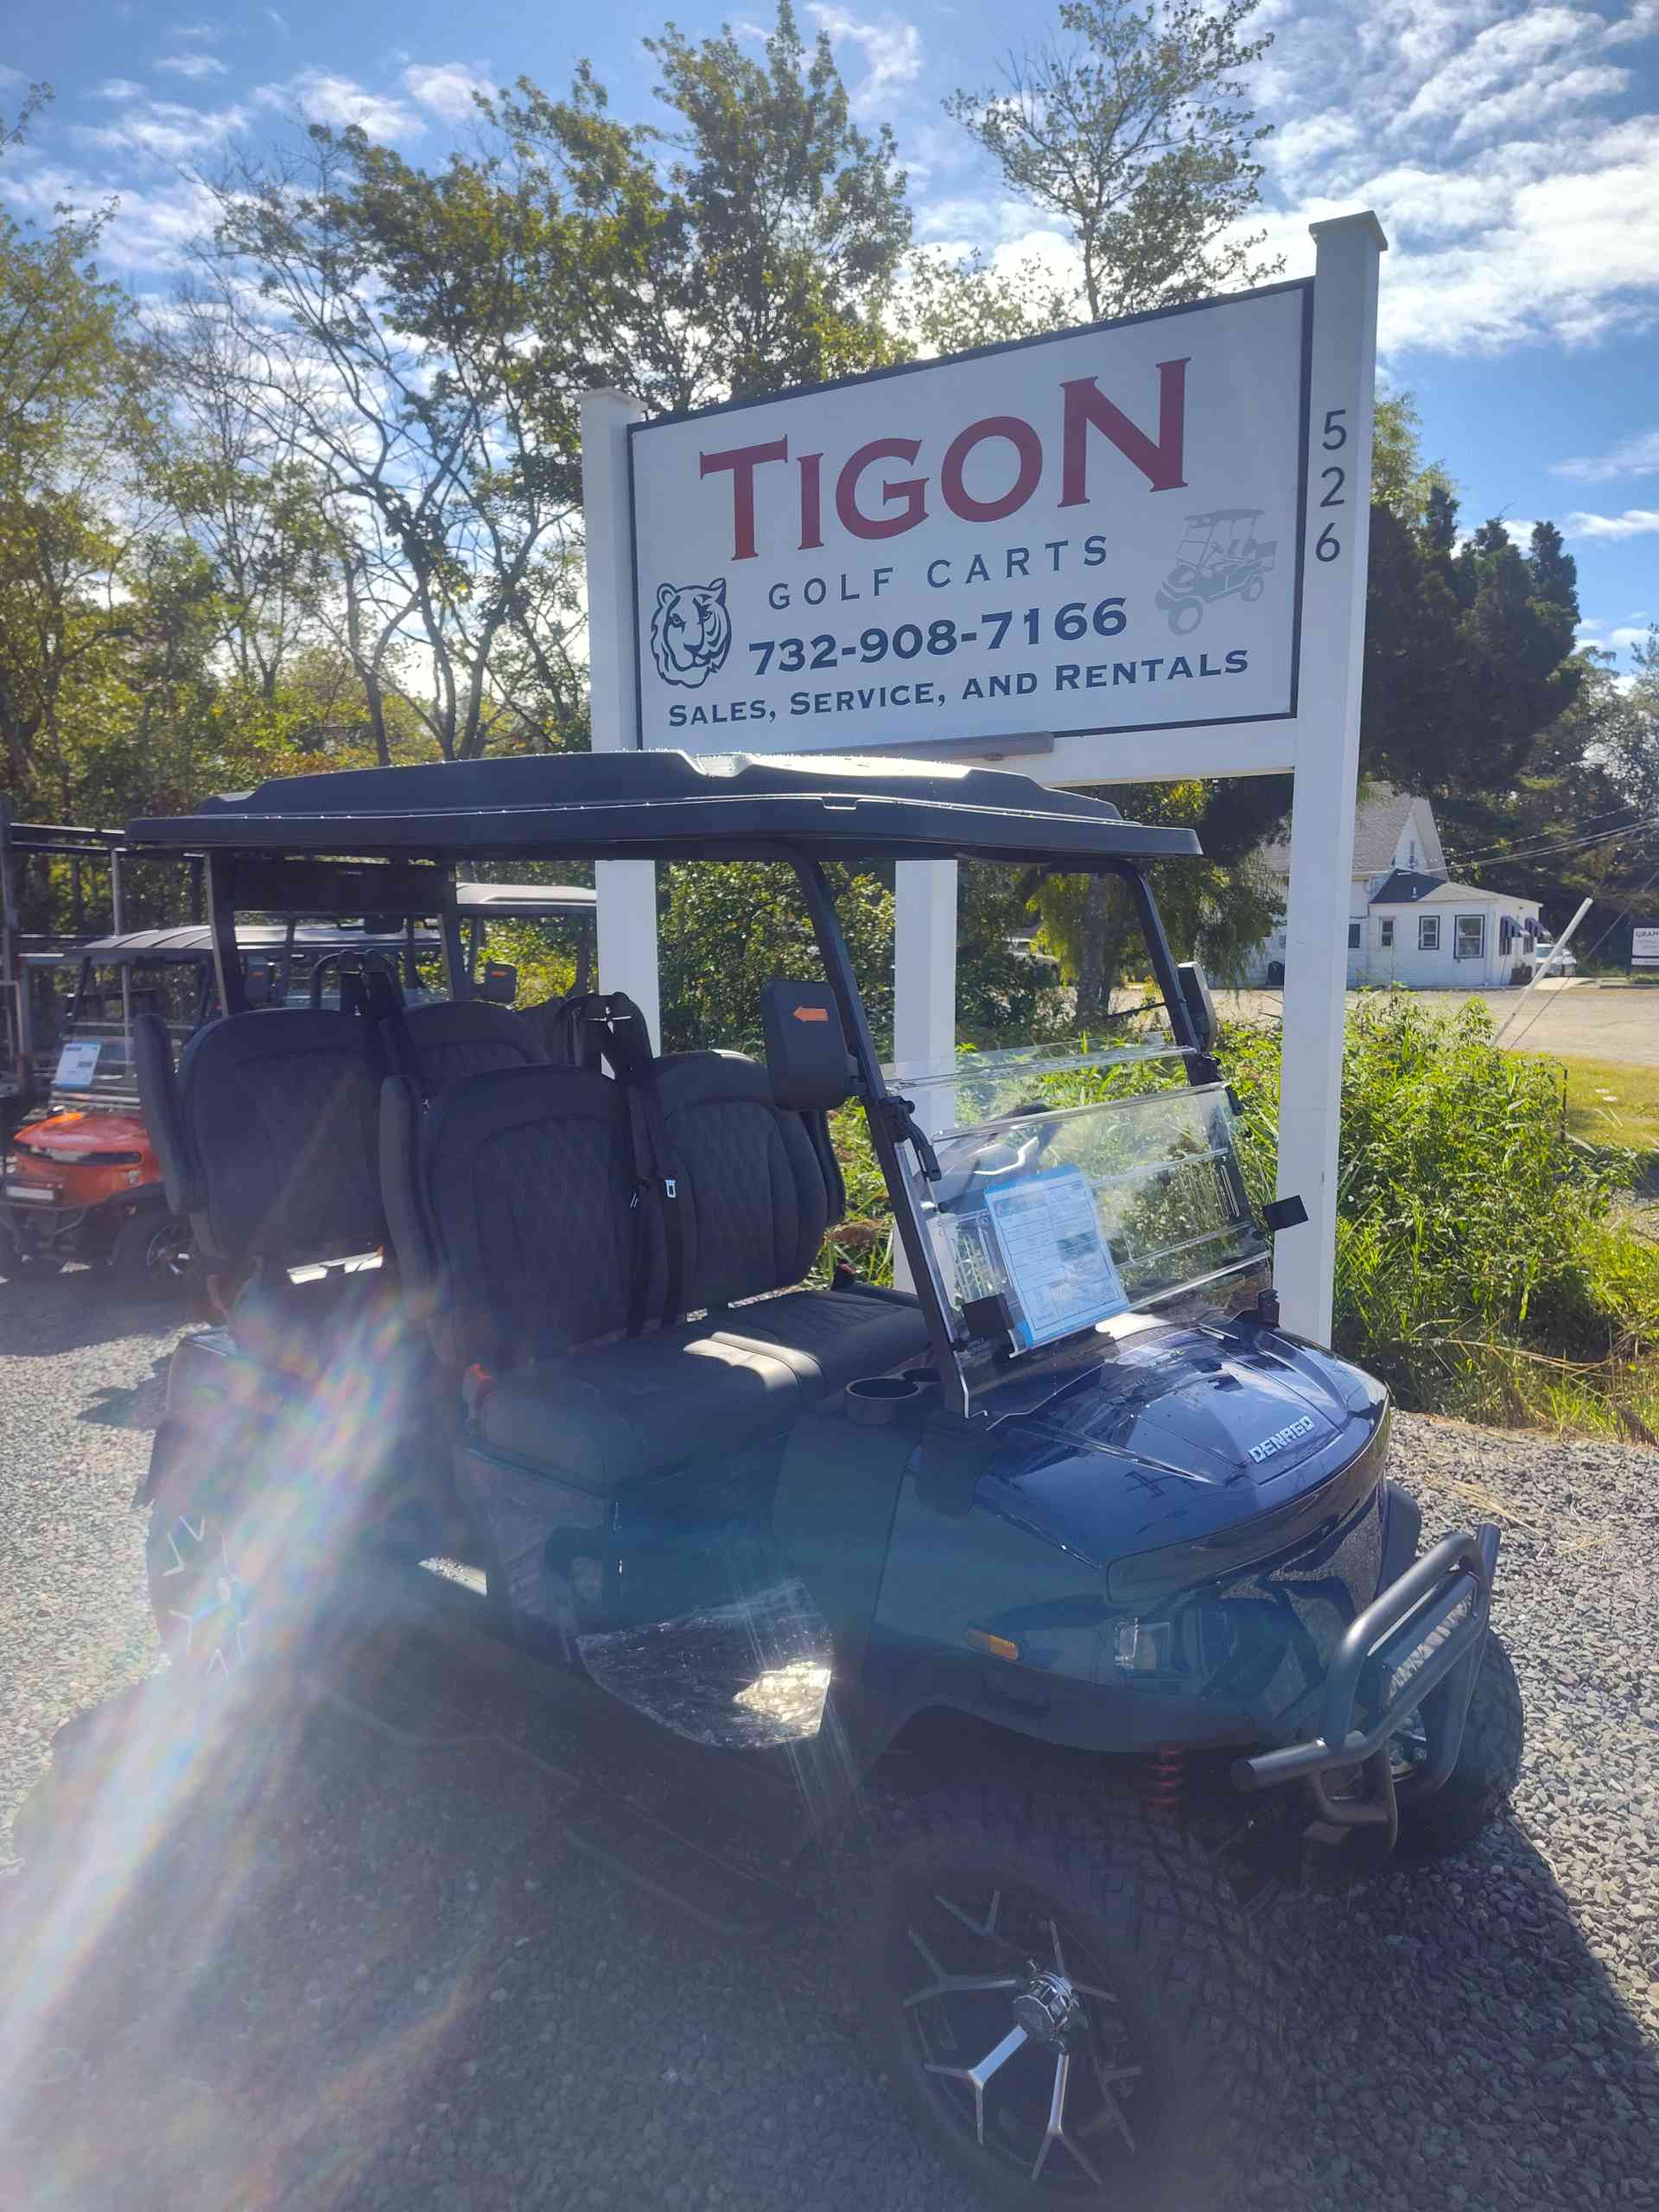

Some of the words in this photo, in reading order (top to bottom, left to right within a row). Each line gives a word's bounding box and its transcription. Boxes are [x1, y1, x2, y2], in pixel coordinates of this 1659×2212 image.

[700, 358, 1192, 561] TIGON
[768, 566, 894, 610] GOLF
[926, 535, 1108, 588] CARTS
[748, 597, 1128, 676] 732-908-7166
[669, 699, 776, 728] SALES,
[790, 682, 947, 715] SERVICE,
[961, 672, 1038, 700] AND
[1054, 650, 1249, 691] RENTALS
